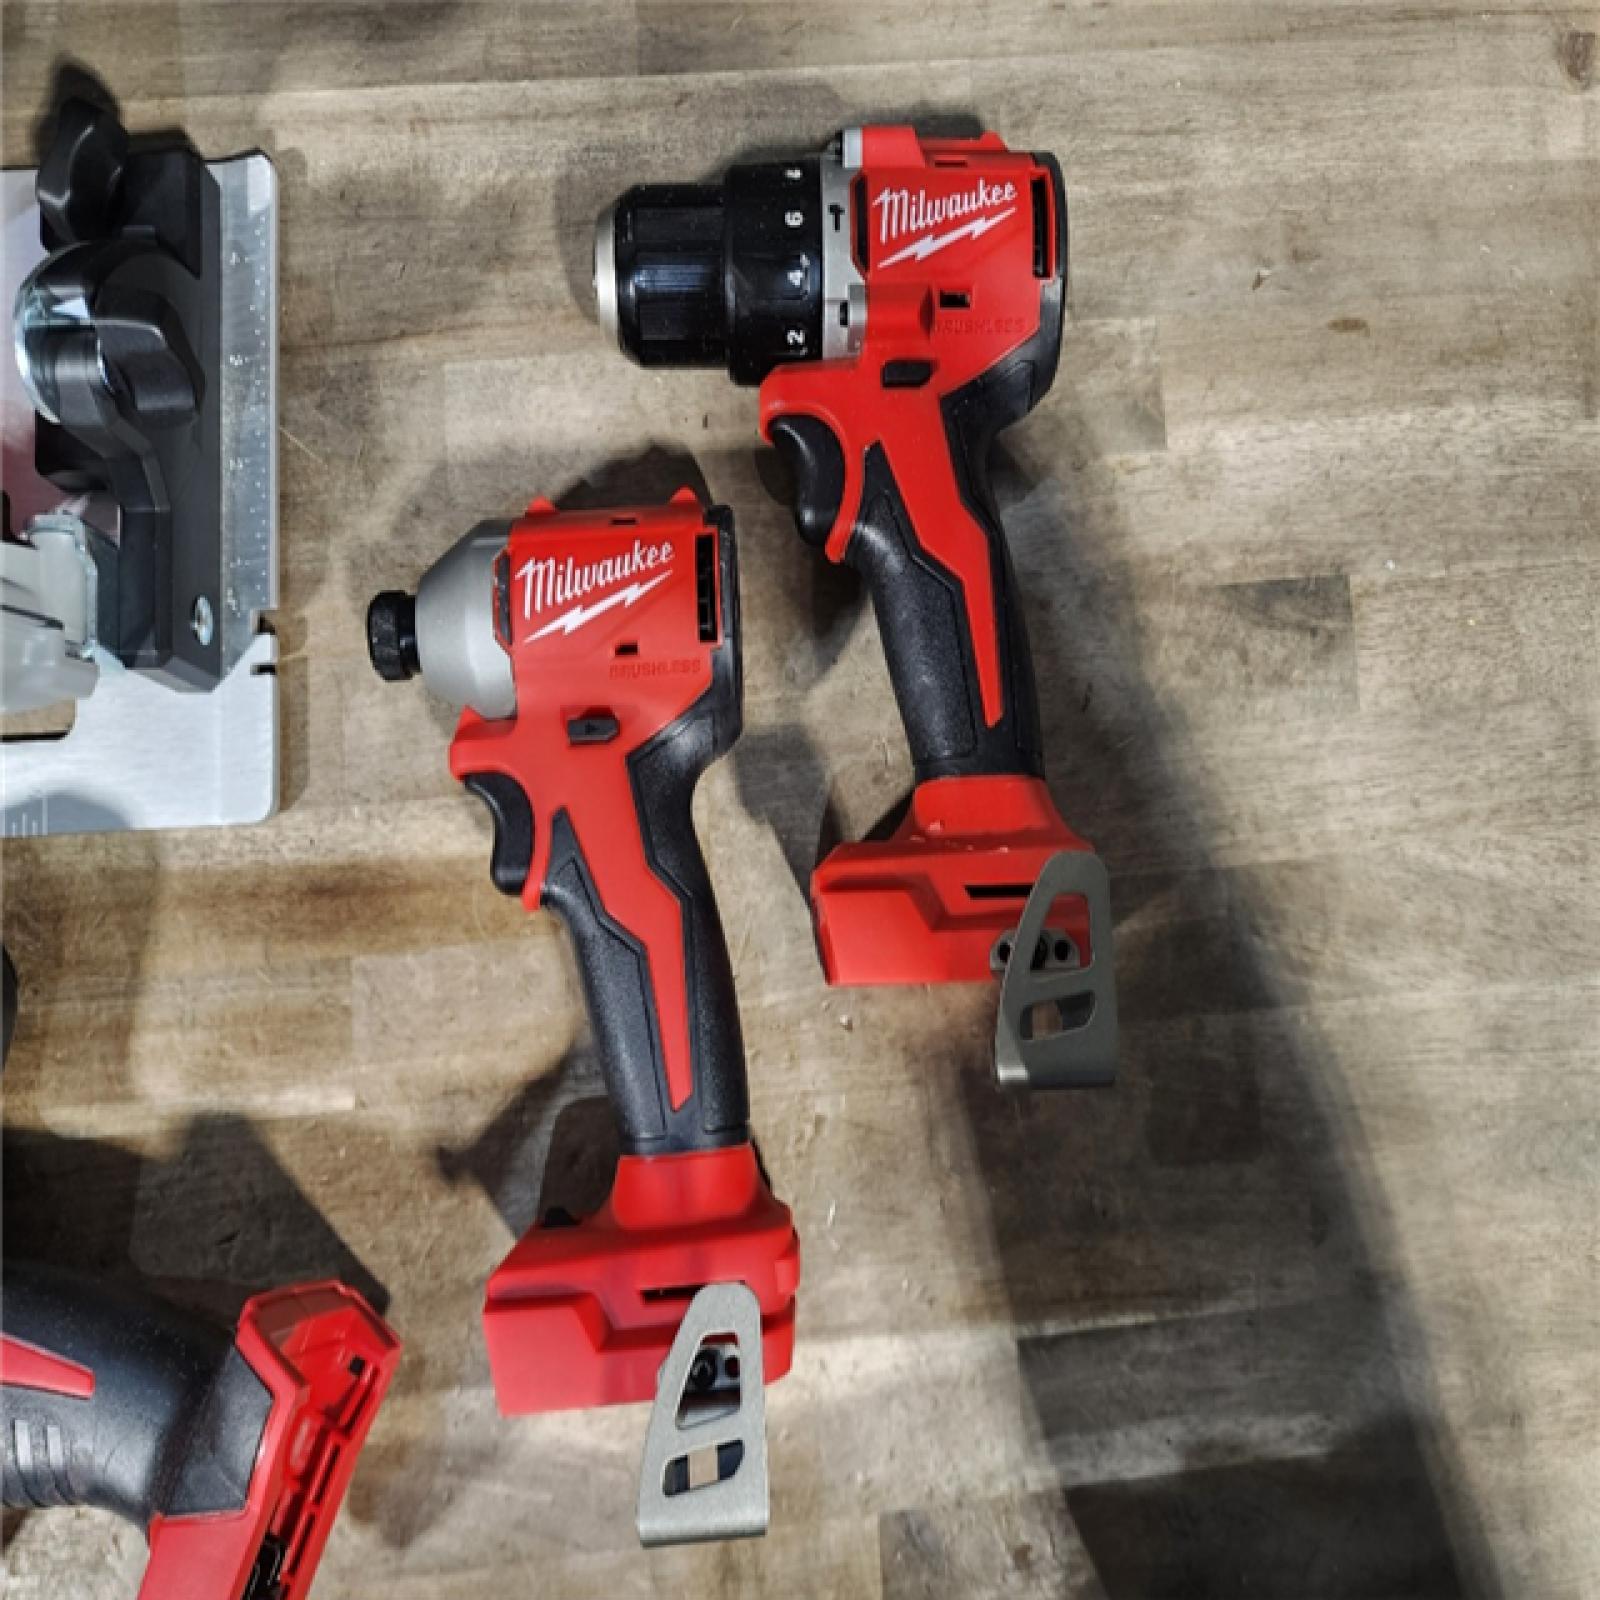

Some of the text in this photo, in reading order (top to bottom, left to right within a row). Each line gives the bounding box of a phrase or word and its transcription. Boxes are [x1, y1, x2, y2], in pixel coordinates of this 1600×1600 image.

[873, 178, 1018, 244] Milwaukee
[786, 329, 805, 346] 2
[515, 539, 675, 620] Milwaukee
